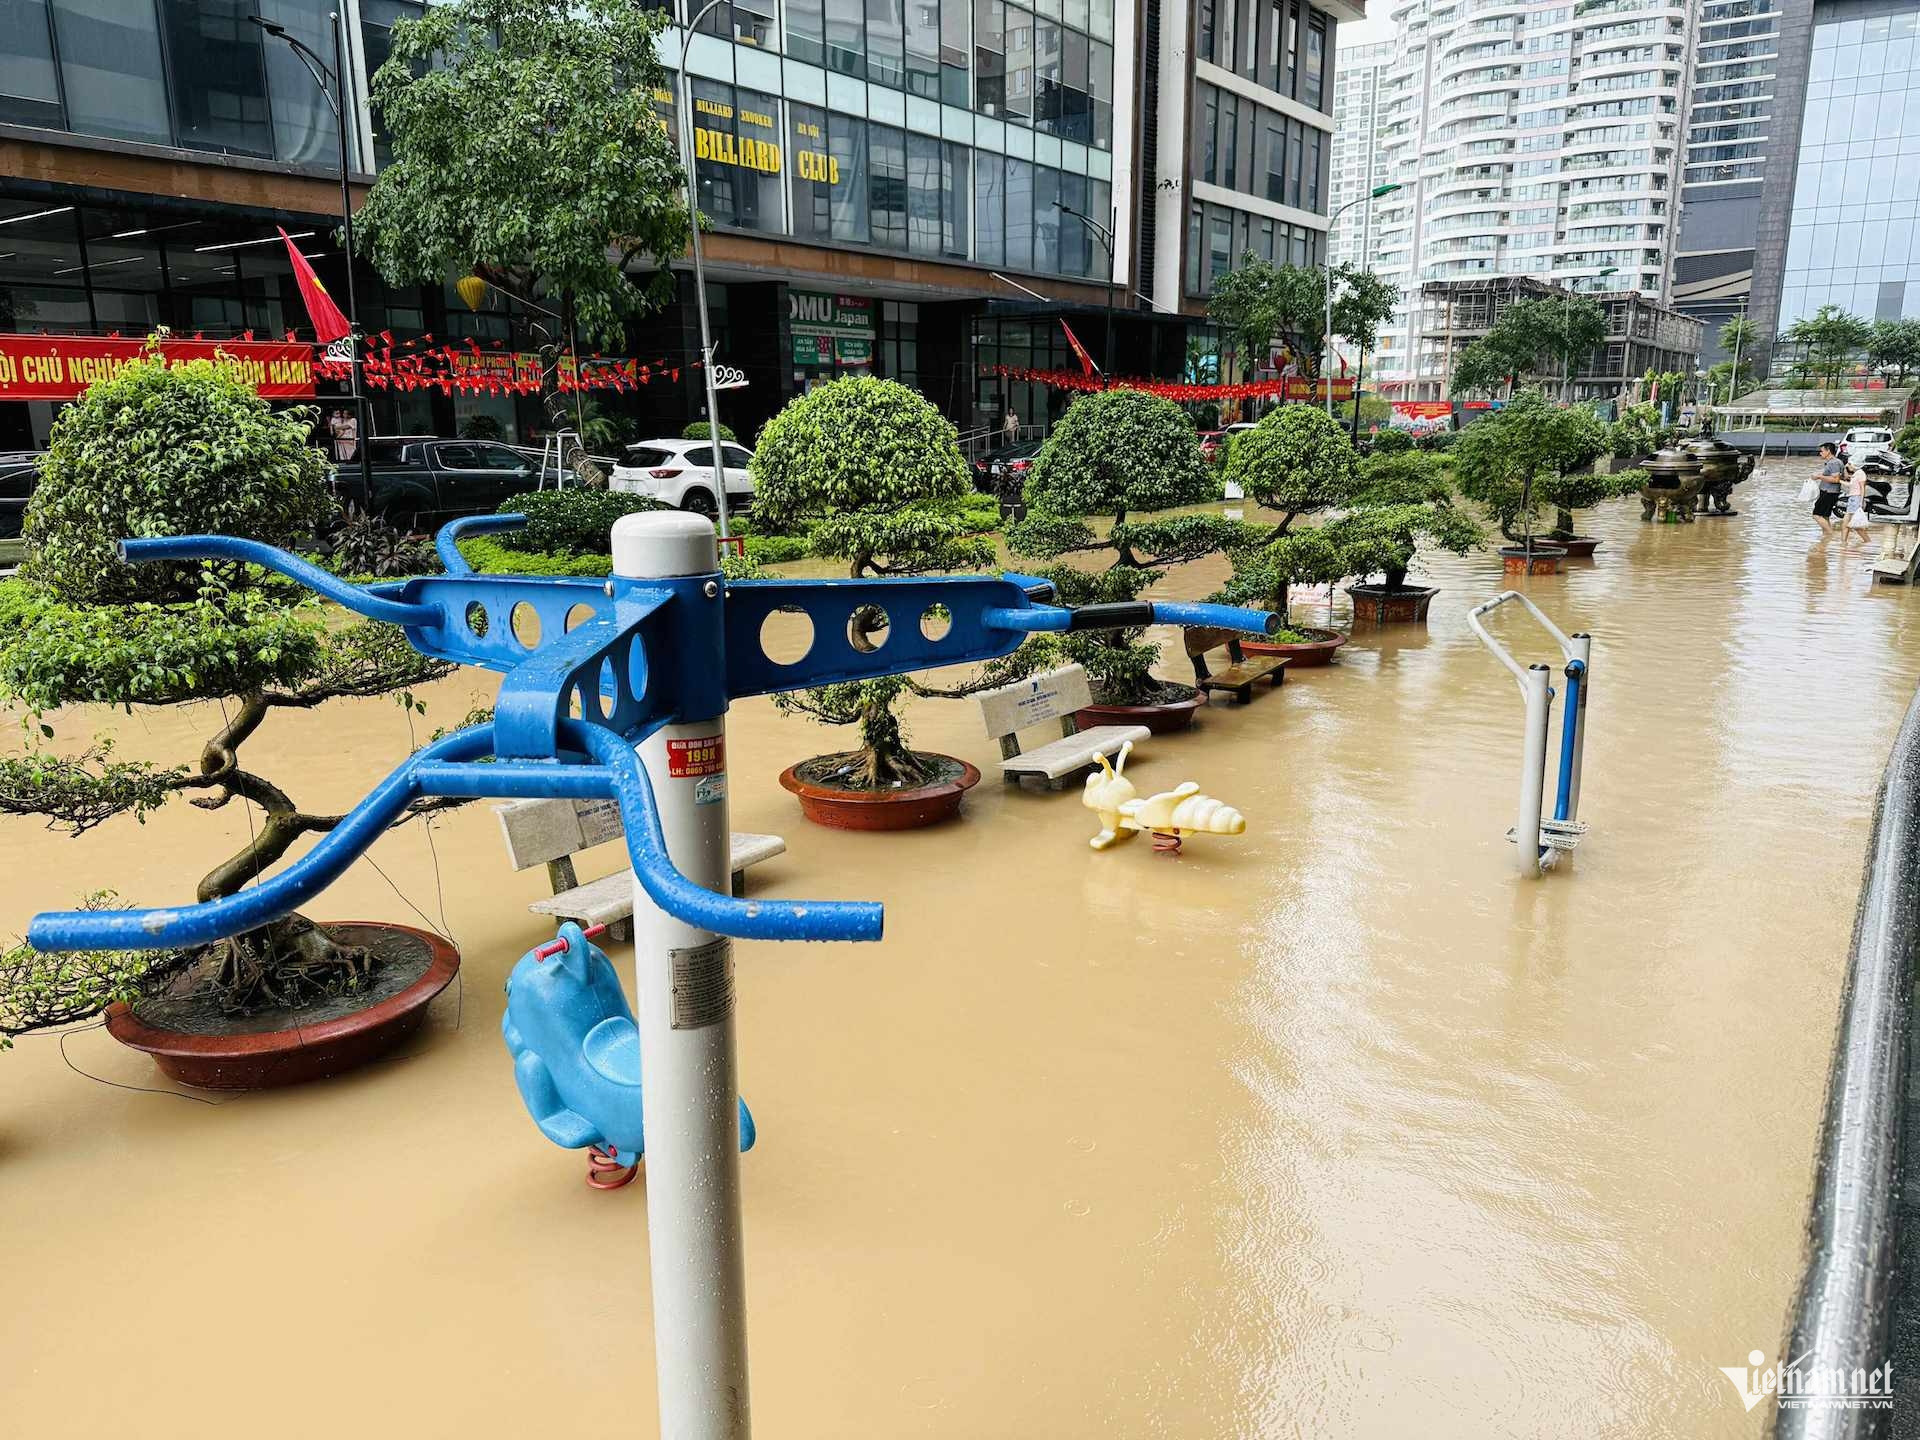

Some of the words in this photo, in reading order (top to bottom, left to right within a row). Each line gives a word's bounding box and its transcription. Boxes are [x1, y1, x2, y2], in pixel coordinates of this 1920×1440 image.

[696, 100, 733, 118] BILLIARD
[740, 110, 773, 128] SNOOKER
[694, 127, 780, 173] BILLIARD
[798, 150, 839, 185] CLUB
[835, 309, 869, 326] Japan
[23, 347, 62, 383] CHỦ
[269, 356, 312, 385] NĂM!
[686, 747, 716, 763] 199K
